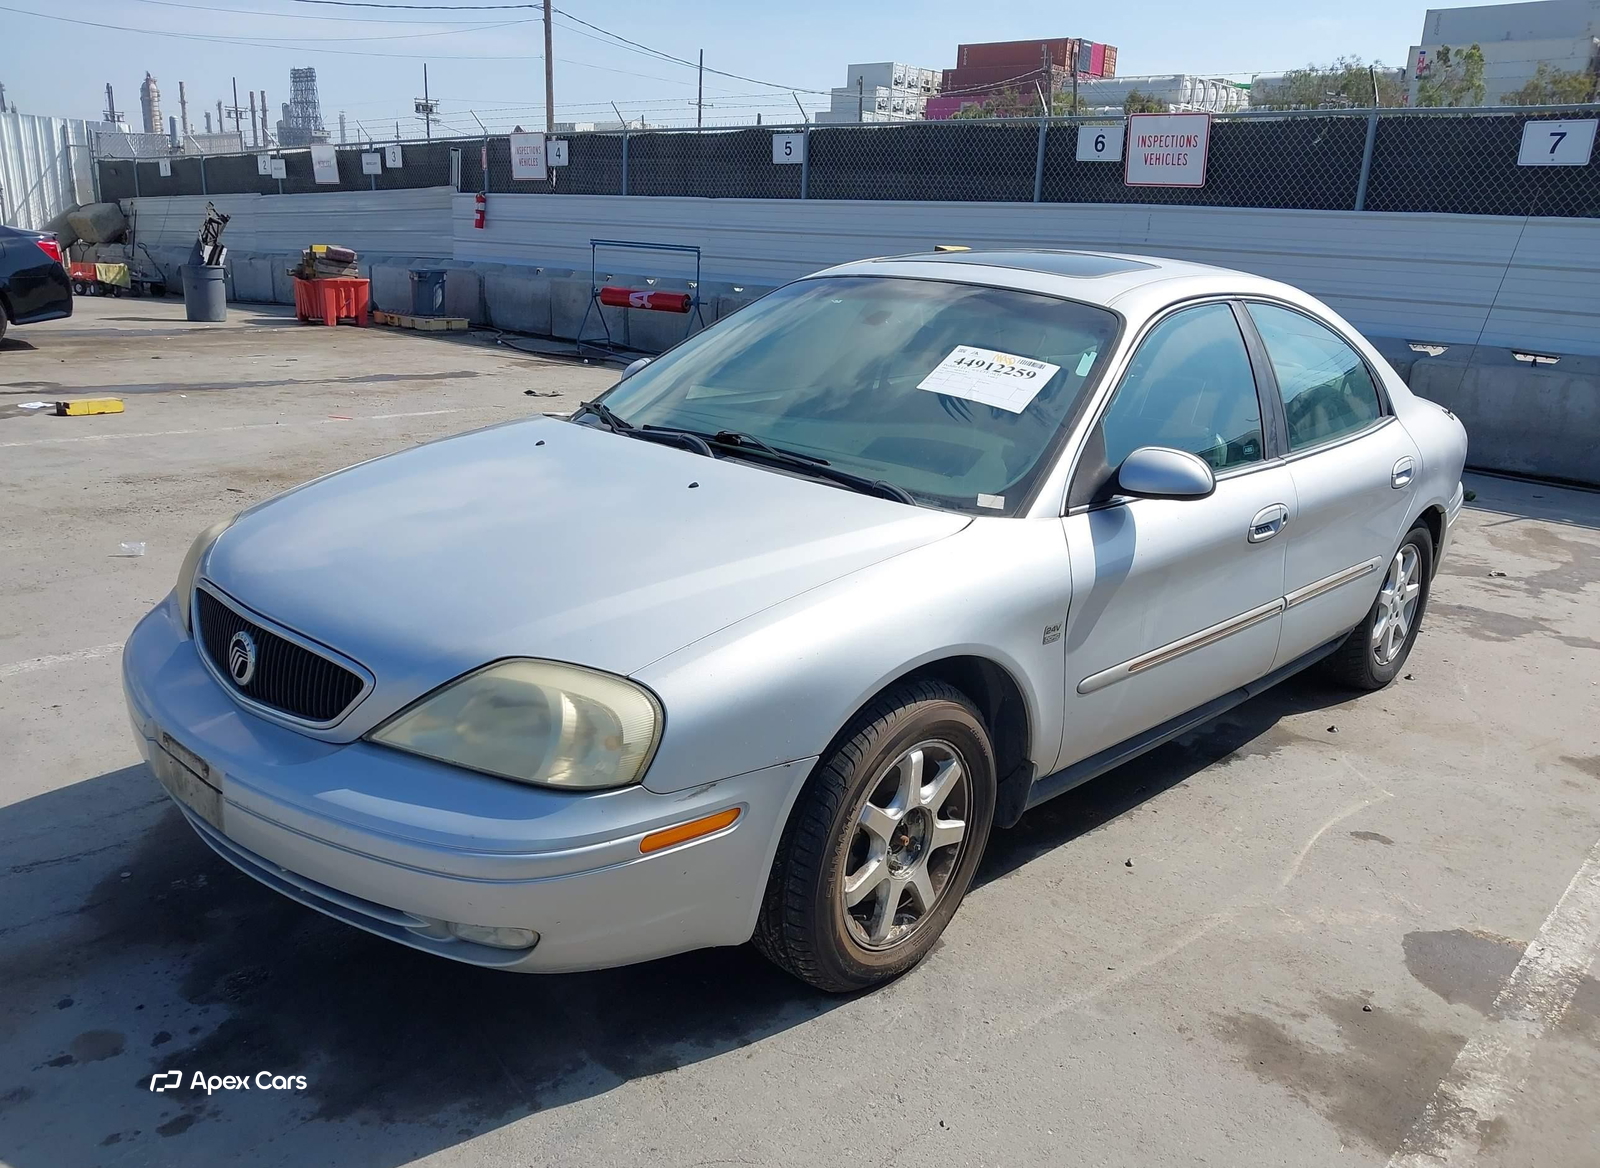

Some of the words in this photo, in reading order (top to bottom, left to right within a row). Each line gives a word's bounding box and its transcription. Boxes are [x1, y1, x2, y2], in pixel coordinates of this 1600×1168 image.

[1094, 134, 1106, 152] 6
[1137, 135, 1198, 148] INSPECTIONS
[1549, 132, 1567, 154] 7
[514, 146, 542, 155] INSPECTIONS
[556, 147, 562, 159] 4
[785, 142, 792, 156] 5
[391, 151, 397, 163] 3
[518, 158, 539, 167] VEHICLES
[1143, 152, 1188, 166] VEHICLES
[263, 160, 268, 170] 2
[953, 357, 1037, 380] 44912259
